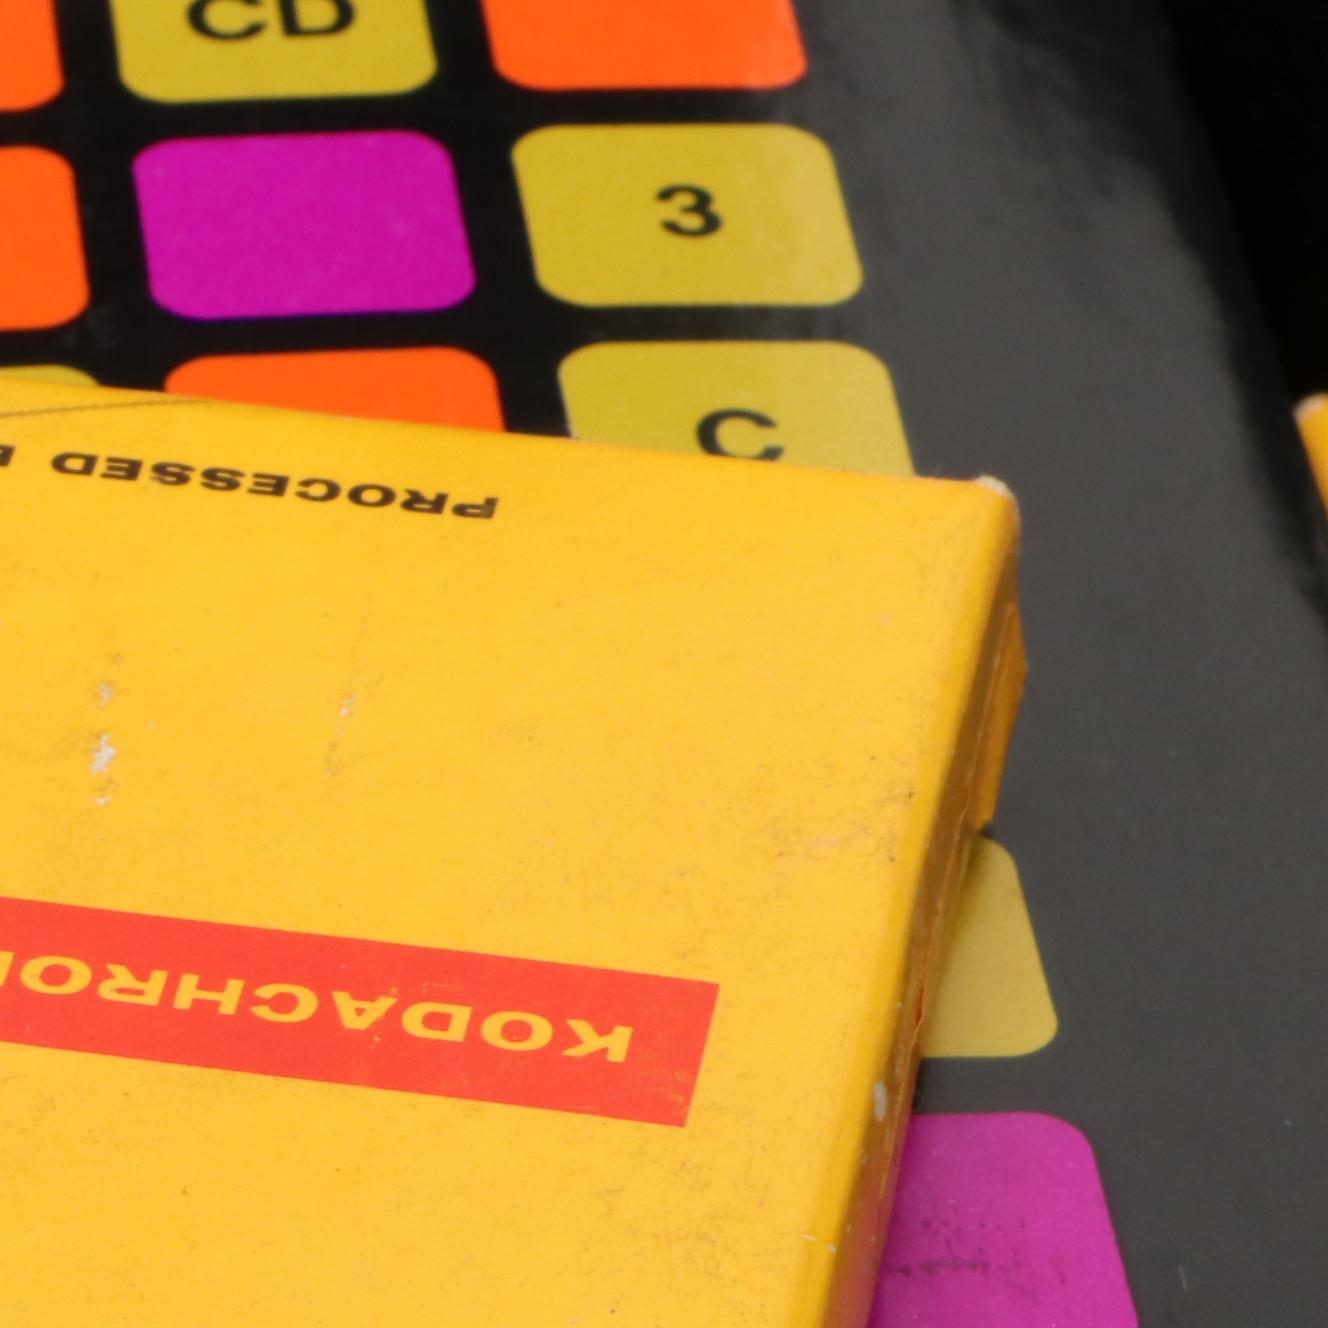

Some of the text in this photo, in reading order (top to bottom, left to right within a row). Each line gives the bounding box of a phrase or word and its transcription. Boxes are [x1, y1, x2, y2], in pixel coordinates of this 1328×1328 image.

[187, 0, 356, 40] CD
[655, 185, 722, 237] 3
[51, 451, 500, 520] PROCESSED
